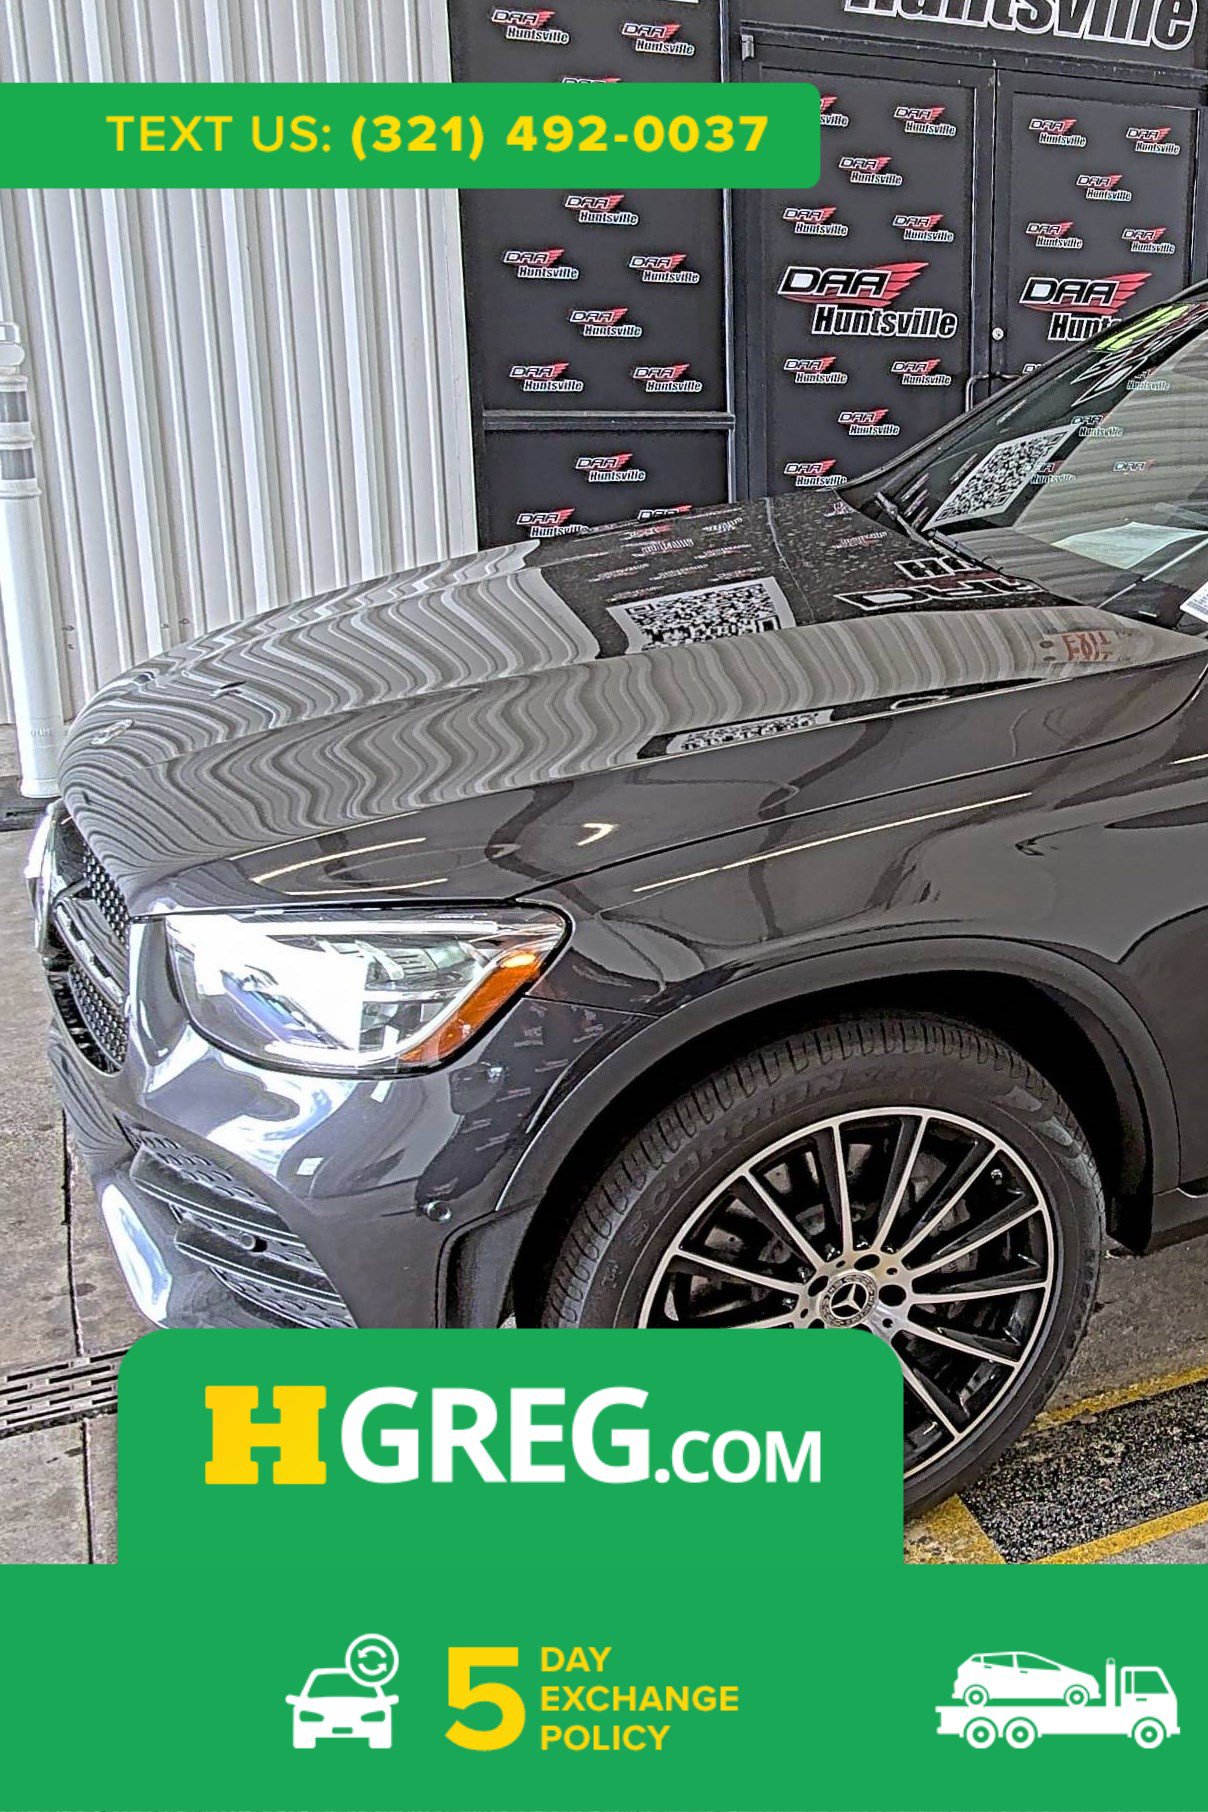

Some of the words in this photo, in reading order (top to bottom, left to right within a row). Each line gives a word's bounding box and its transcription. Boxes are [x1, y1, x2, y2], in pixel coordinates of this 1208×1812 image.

[491, 9, 539, 25] DAA
[621, 23, 667, 38] DAA
[844, 0, 1198, 50] sville
[506, 26, 569, 44] Huntsville
[636, 38, 695, 56] Huntsville
[894, 106, 932, 120] DAA
[820, 114, 849, 127] sville
[905, 121, 956, 137] Huntsville
[839, 157, 878, 170] DAA
[850, 171, 903, 186] Huntsville
[565, 195, 609, 209] DAA
[579, 210, 639, 225] Huntsville
[783, 208, 824, 221] DAA
[893, 215, 931, 228] DAA
[795, 223, 848, 236] Huntsville
[904, 229, 954, 242] Huntsville
[504, 250, 549, 264] DAA
[629, 256, 671, 269] DAA
[518, 266, 579, 280] Huntsville
[642, 270, 700, 283] Huntsville
[778, 266, 892, 298] DAA
[1019, 276, 1119, 306] DAA
[570, 310, 613, 323] DAA
[812, 304, 958, 338] Huntsville
[583, 325, 642, 337] Huntsville
[784, 359, 823, 371] DAA
[891, 362, 929, 373] DAA
[509, 366, 554, 378] DAA
[632, 367, 674, 379] DAA
[795, 372, 848, 384] Huntsville
[523, 380, 584, 391] Huntsville
[902, 374, 951, 385] Huntsville
[645, 381, 702, 392] Huntsville
[838, 412, 876, 423] DAA
[849, 424, 900, 435] Huntsville
[576, 457, 618, 469] DAA
[784, 463, 824, 474] DAA
[589, 470, 646, 482] Huntsville
[517, 513, 559, 525] DAA
[530, 525, 588, 538] Huntsvill
